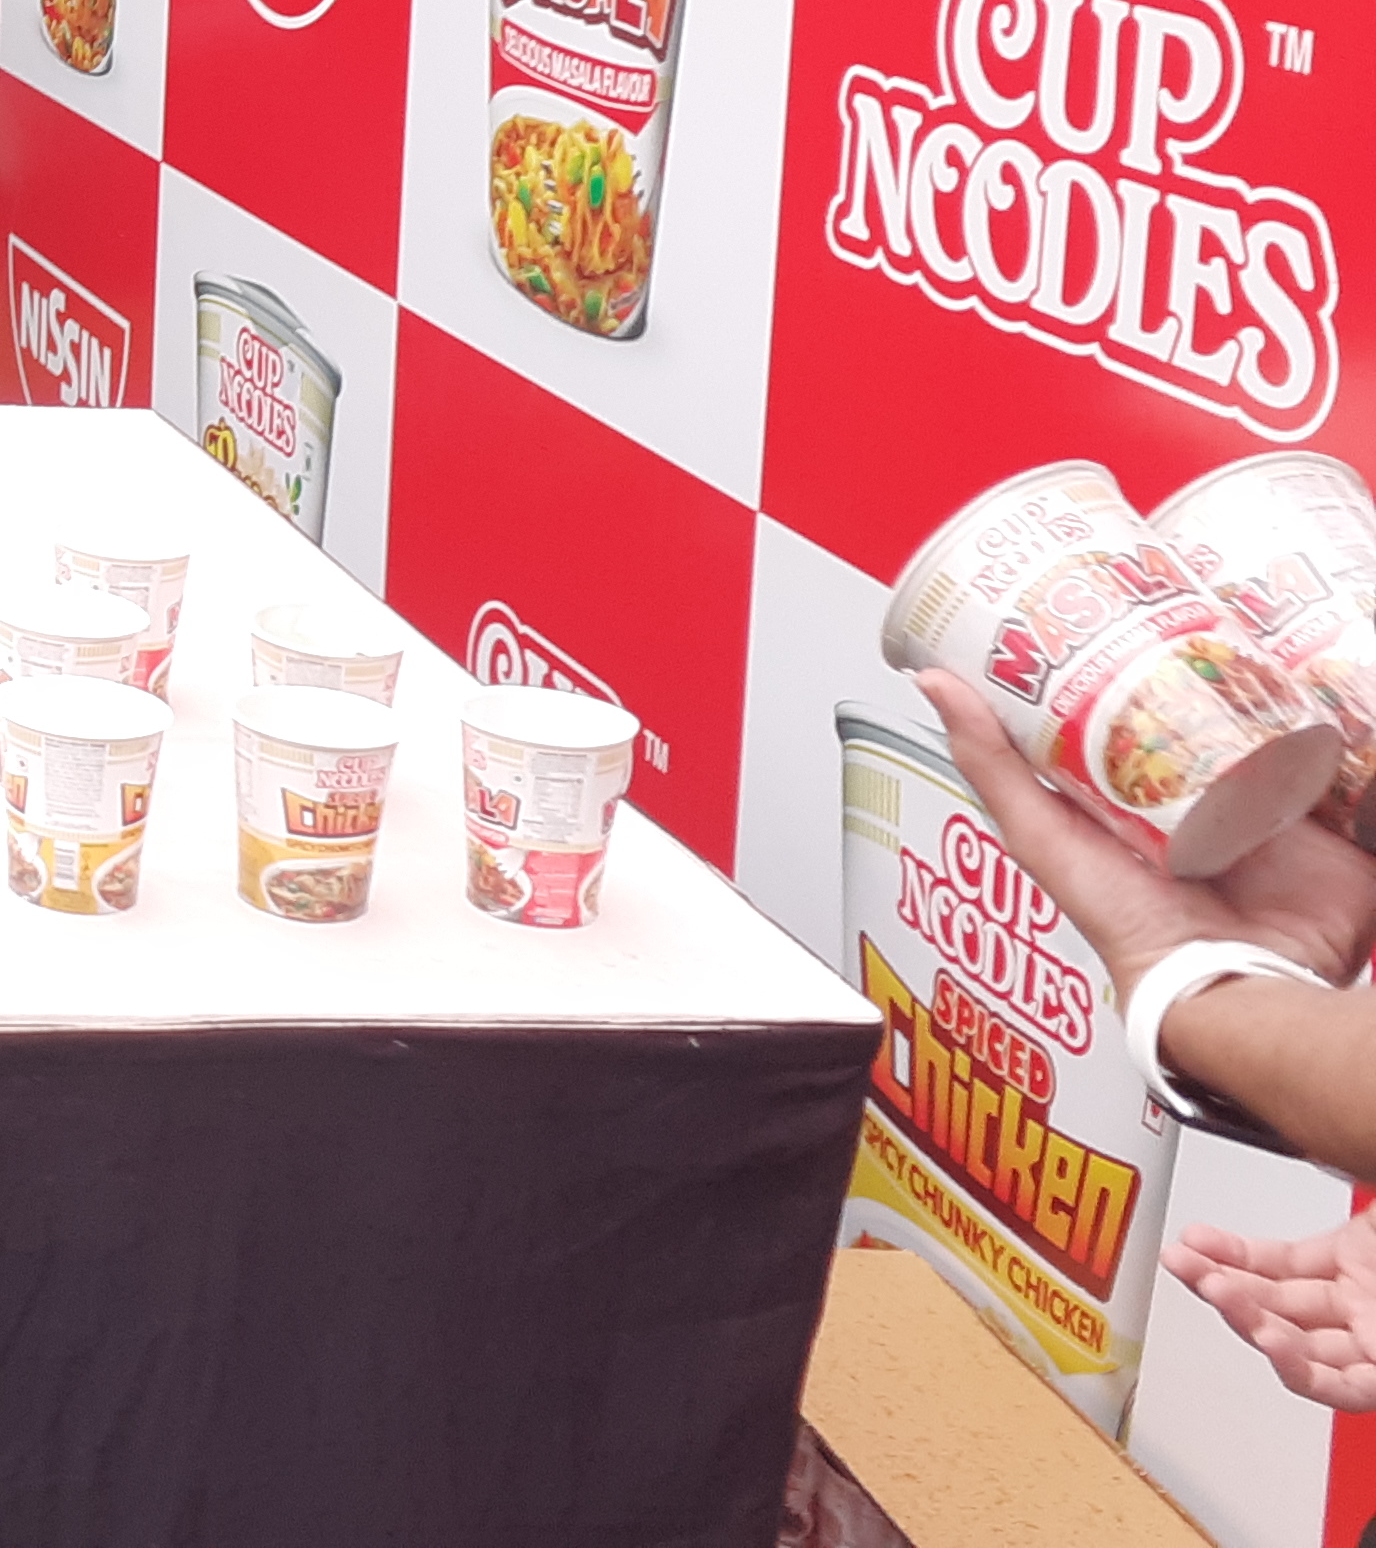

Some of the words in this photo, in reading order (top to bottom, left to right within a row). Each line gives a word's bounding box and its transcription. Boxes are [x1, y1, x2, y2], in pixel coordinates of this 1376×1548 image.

[1264, 21, 1315, 75] TM
[840, 93, 1317, 410] NOODLES
[20, 280, 112, 407] NISSIN
[219, 356, 297, 458] NOODLES
[237, 327, 284, 396] CUP
[642, 728, 670, 774] TM
[941, 813, 1062, 940] CUP
[898, 848, 1094, 1057] NOODLES
[934, 968, 1057, 1104] SPICED
[860, 931, 1141, 1301] Chicken
[908, 1163, 1006, 1274] CHUNKY
[1007, 1255, 1106, 1353] CHICKEN
